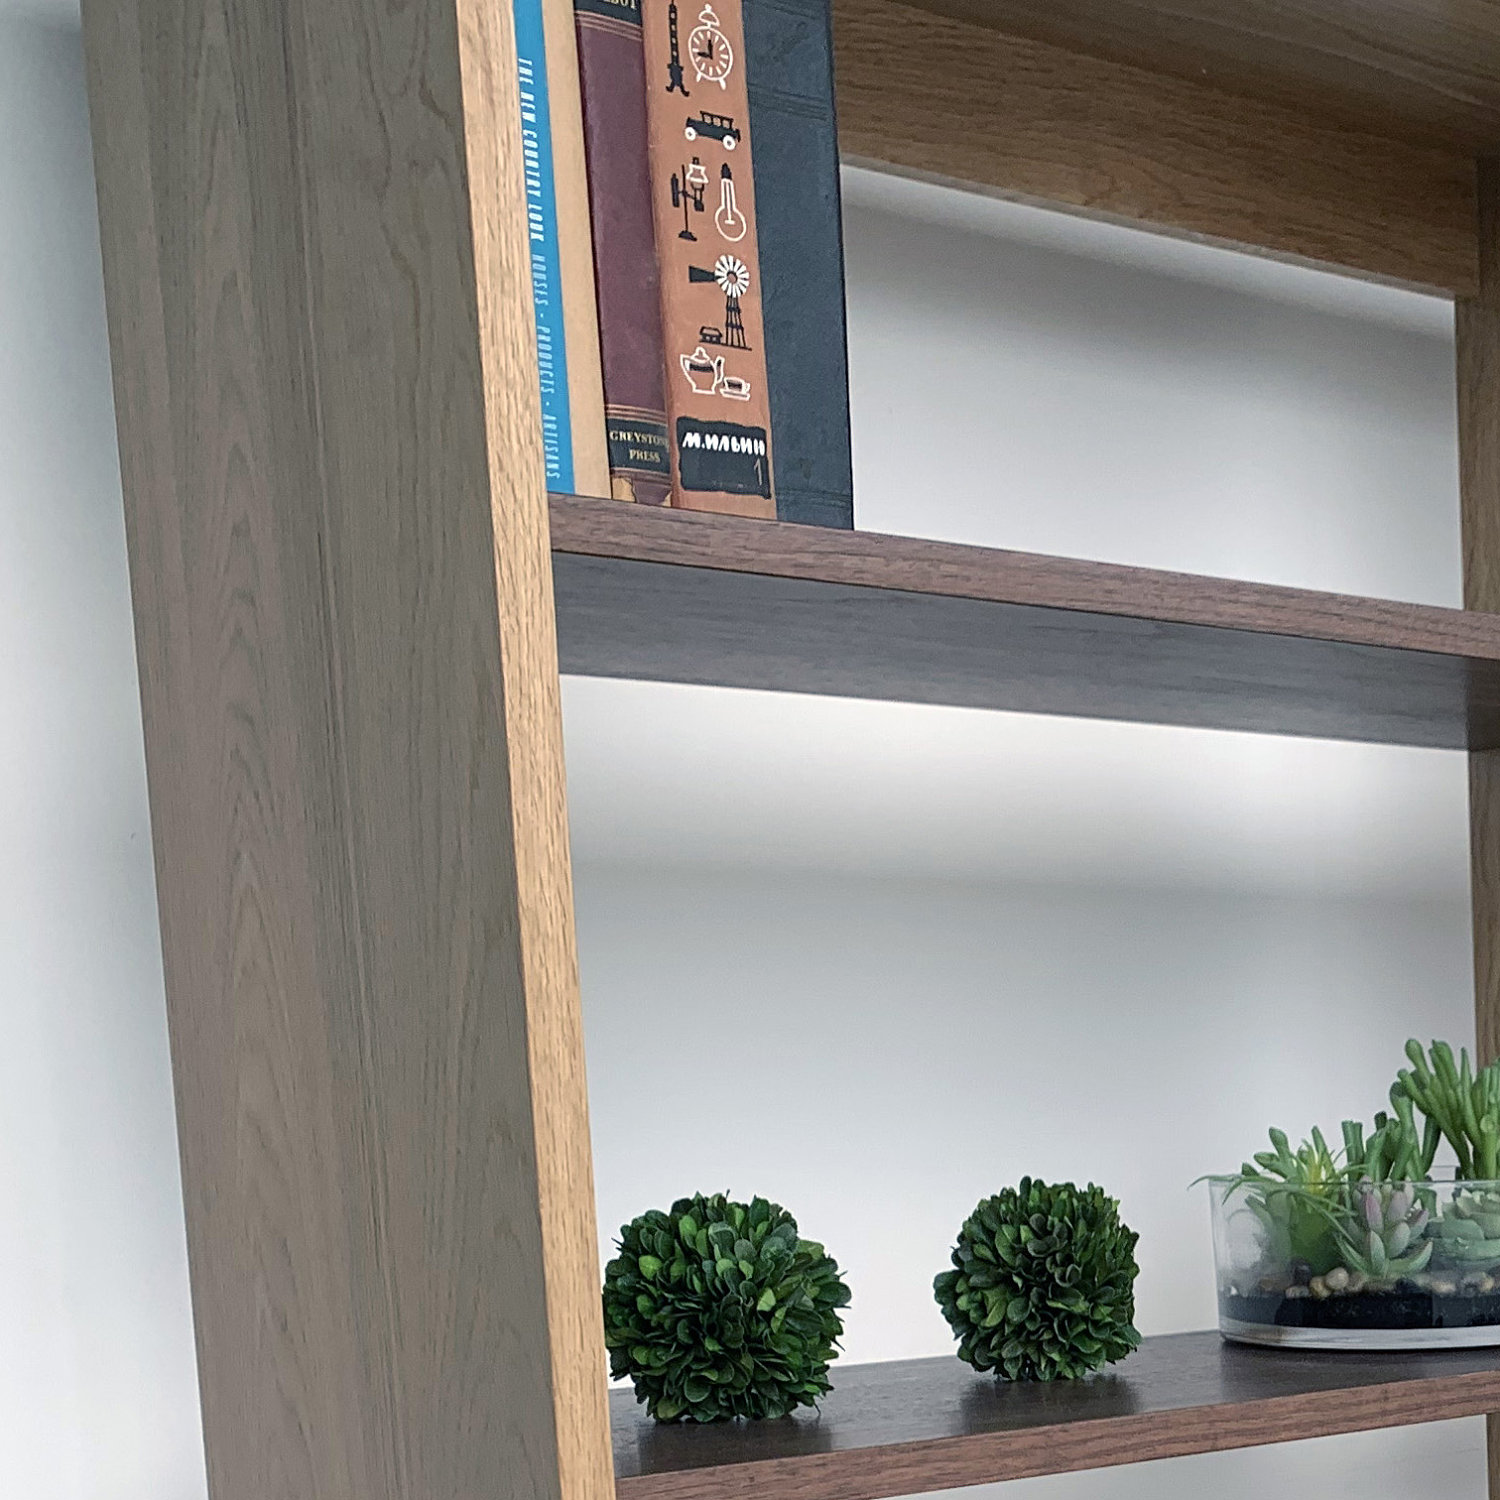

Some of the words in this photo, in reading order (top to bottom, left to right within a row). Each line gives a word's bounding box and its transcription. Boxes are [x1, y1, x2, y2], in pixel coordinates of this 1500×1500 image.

[518, 58, 534, 85] THE
[520, 92, 537, 123] NEW
[523, 129, 541, 198] COUNTRY
[528, 203, 545, 242] LOOK
[532, 254, 549, 305] HOUSES
[537, 325, 555, 394] PRODUCTS
[543, 413, 560, 479] ARTISANS
[629, 448, 661, 463] PRESS
